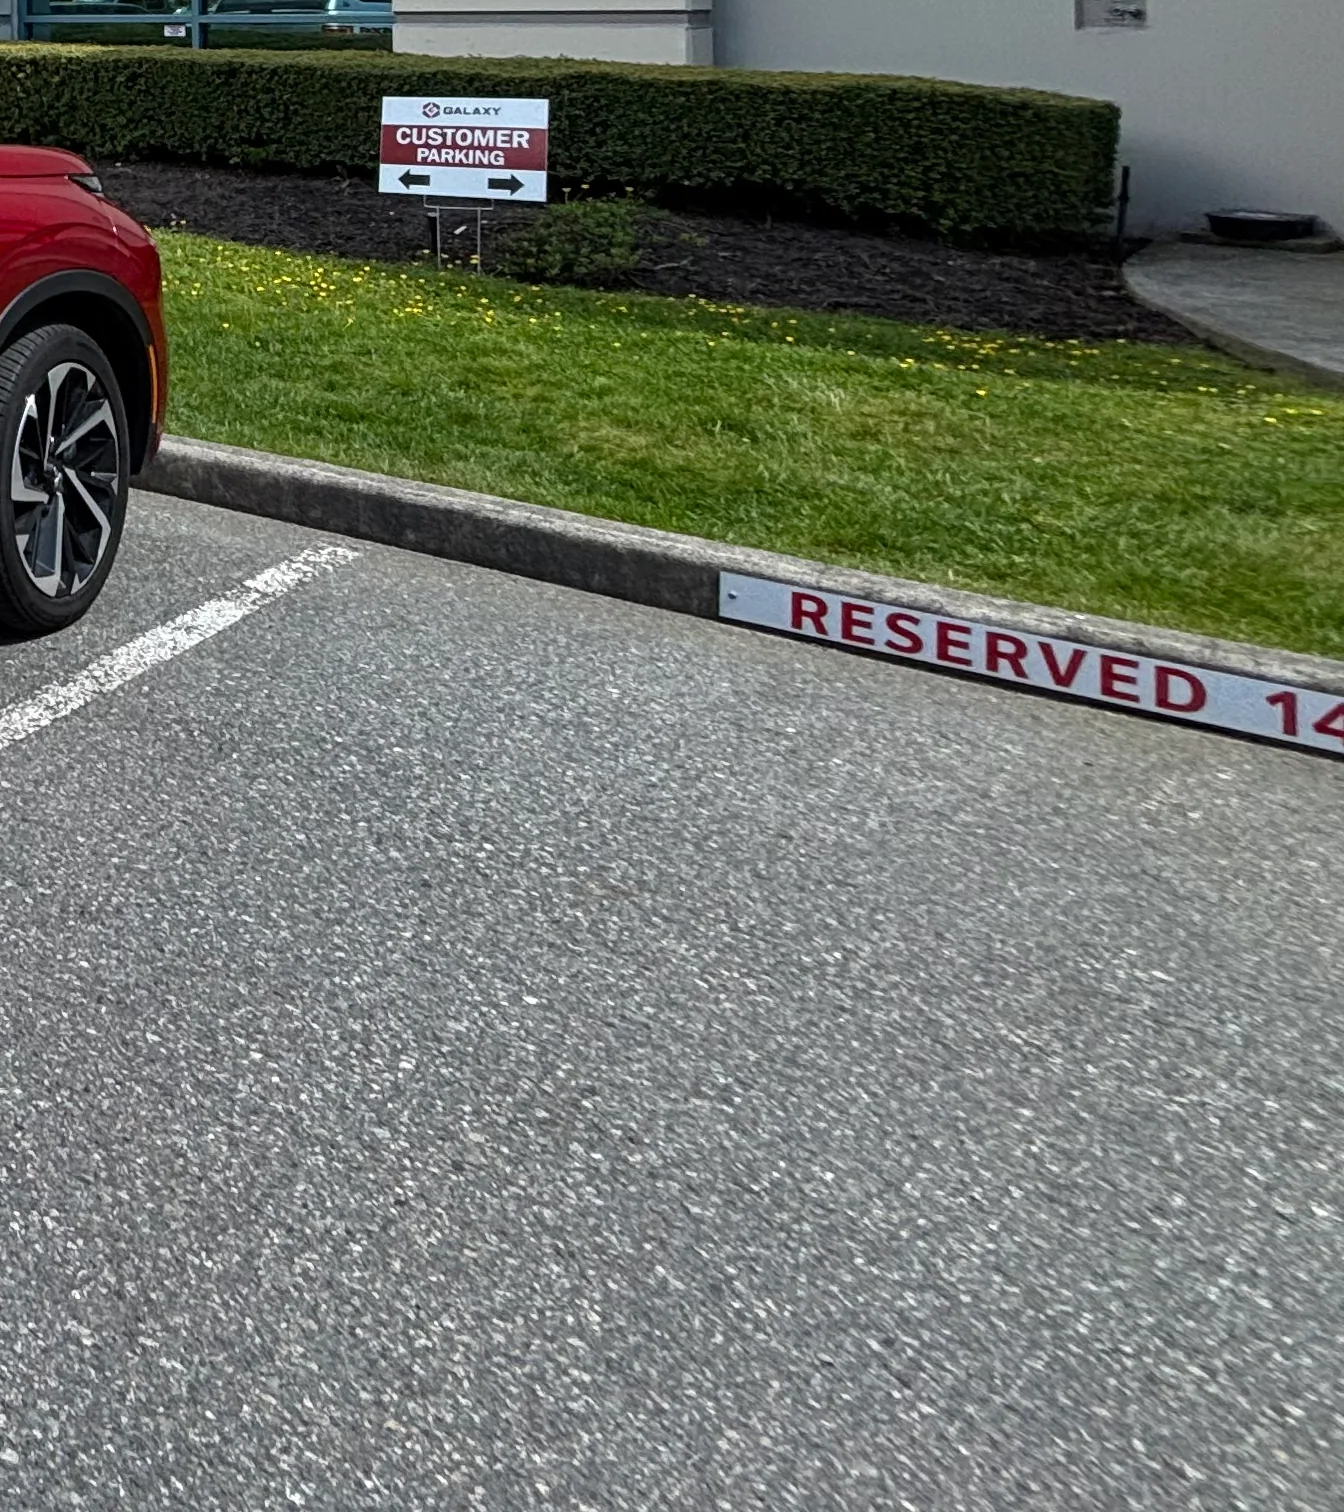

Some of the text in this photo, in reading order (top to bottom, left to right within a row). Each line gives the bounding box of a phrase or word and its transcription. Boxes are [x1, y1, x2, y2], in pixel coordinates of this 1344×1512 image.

[443, 106, 502, 116] GALAXY
[396, 126, 530, 149] CUSTOMER
[416, 147, 505, 166] PARKING
[790, 591, 1344, 747] RESERVED 14
